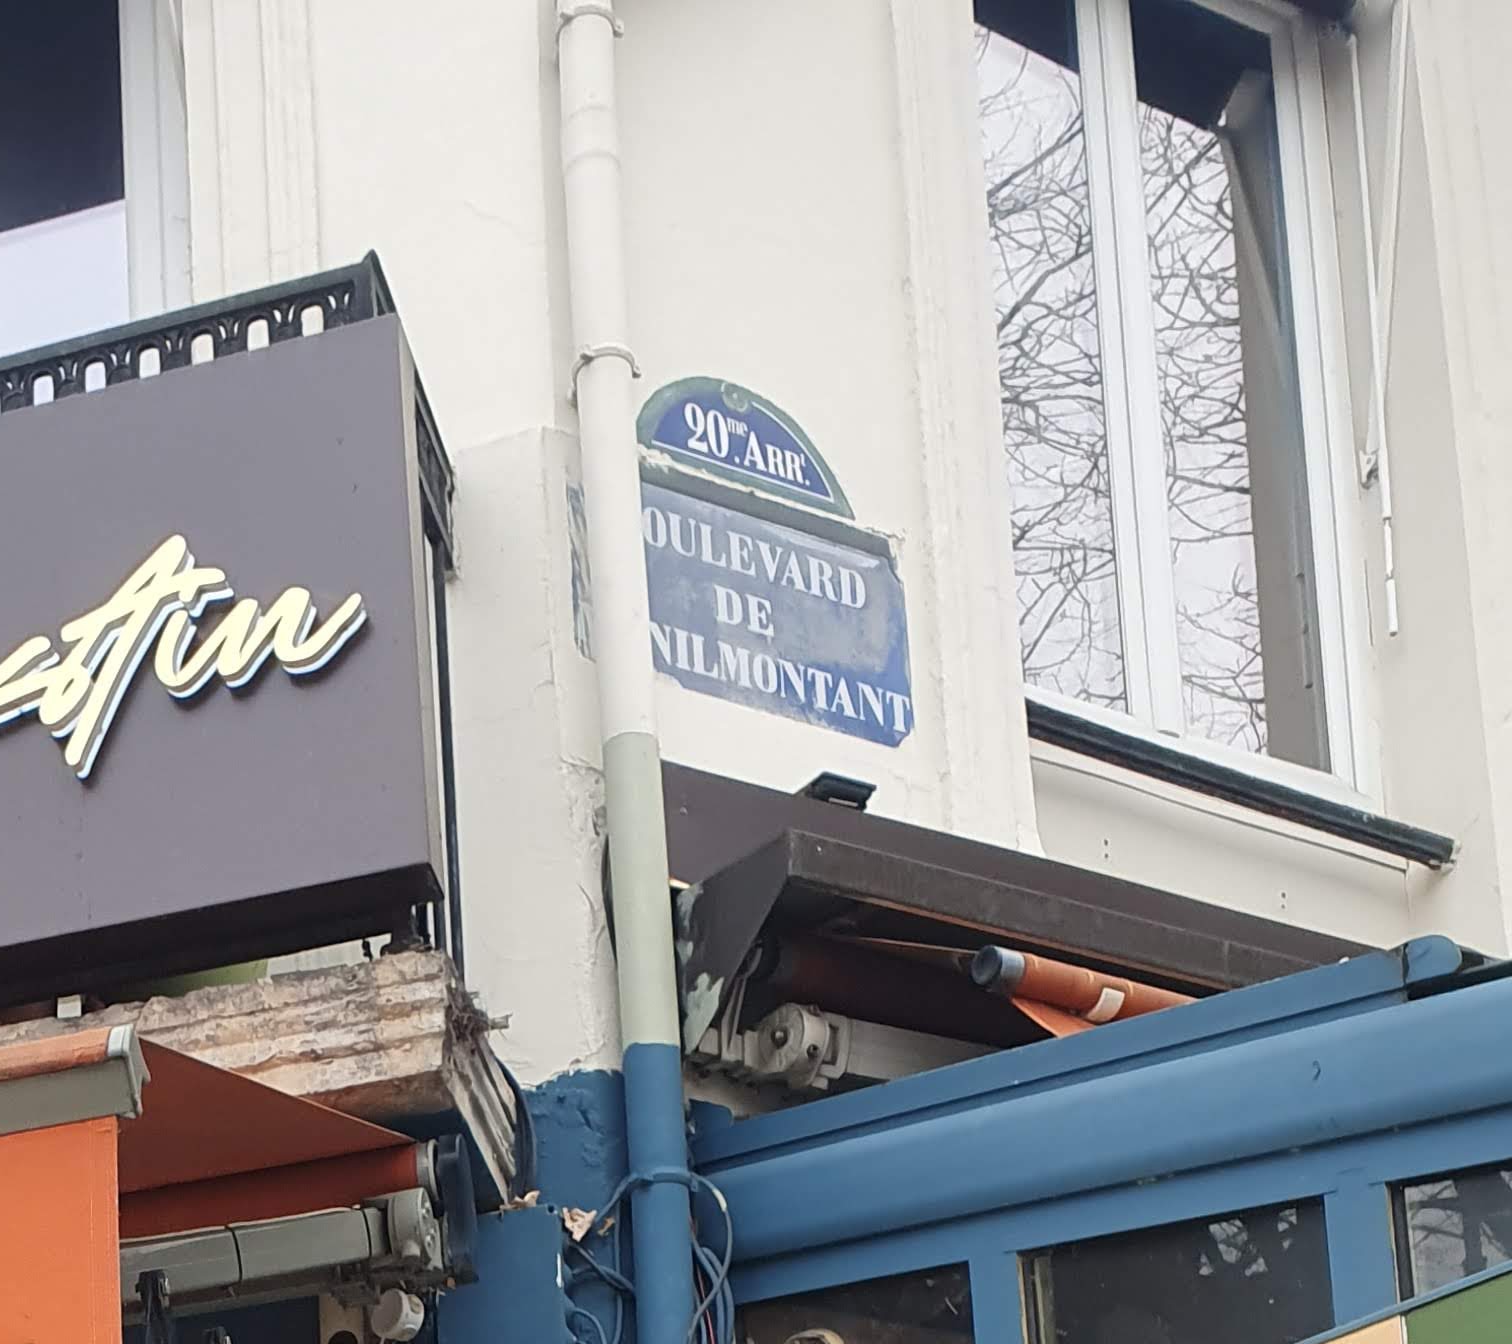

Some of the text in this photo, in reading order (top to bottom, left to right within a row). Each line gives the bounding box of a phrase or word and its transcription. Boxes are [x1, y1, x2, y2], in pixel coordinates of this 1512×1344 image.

[641, 506, 867, 609] OULEVARD
[713, 584, 774, 637] DE
[649, 621, 911, 733] NILMONTANT
